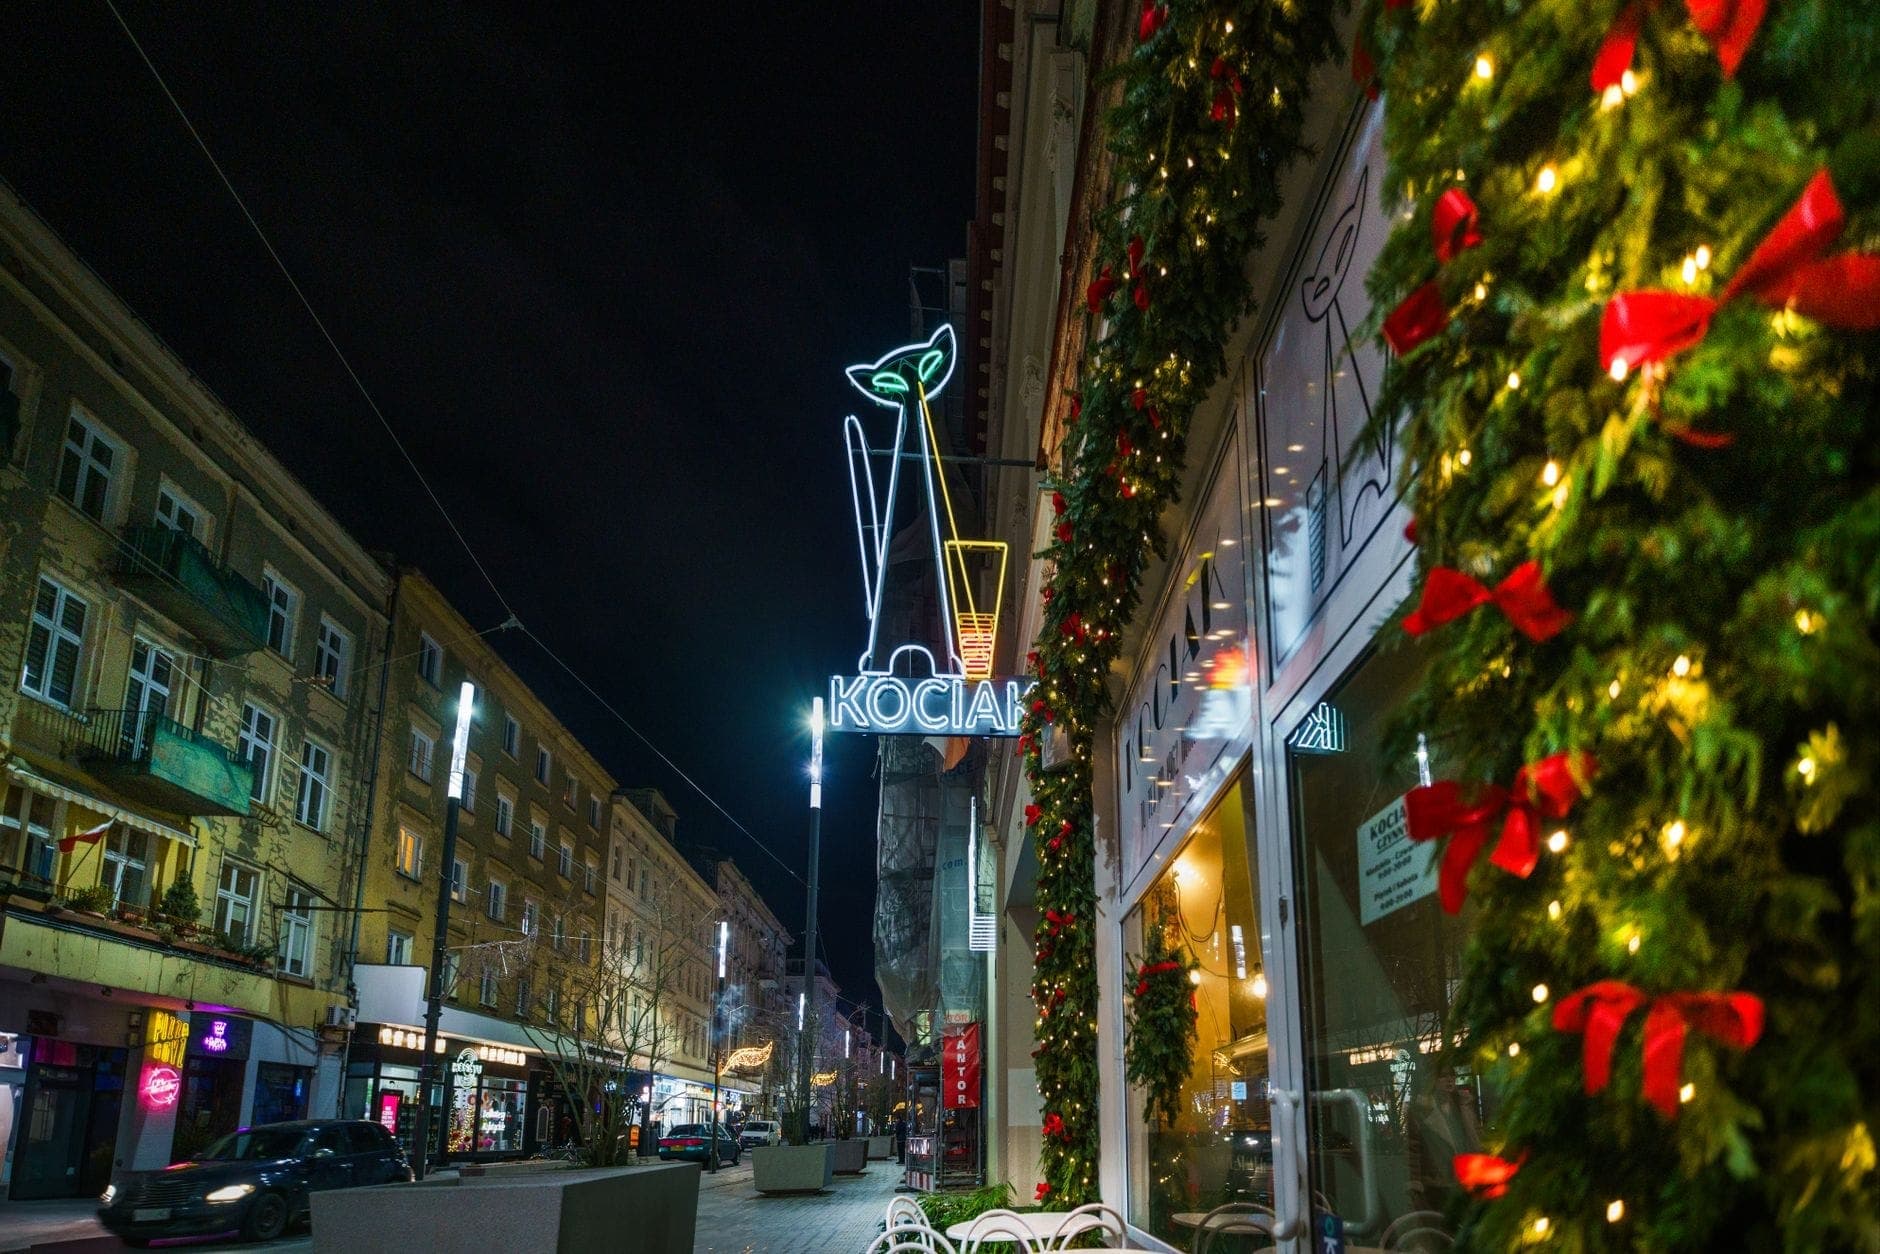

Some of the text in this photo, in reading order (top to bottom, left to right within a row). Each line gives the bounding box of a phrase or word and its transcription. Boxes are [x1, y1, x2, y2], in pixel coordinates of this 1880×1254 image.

[1126, 527, 1225, 794] KOCIAK
[830, 675, 1040, 730] KOCIAK
[1370, 804, 1407, 842] KOCIA
[956, 1027, 967, 1104] KANTOR
